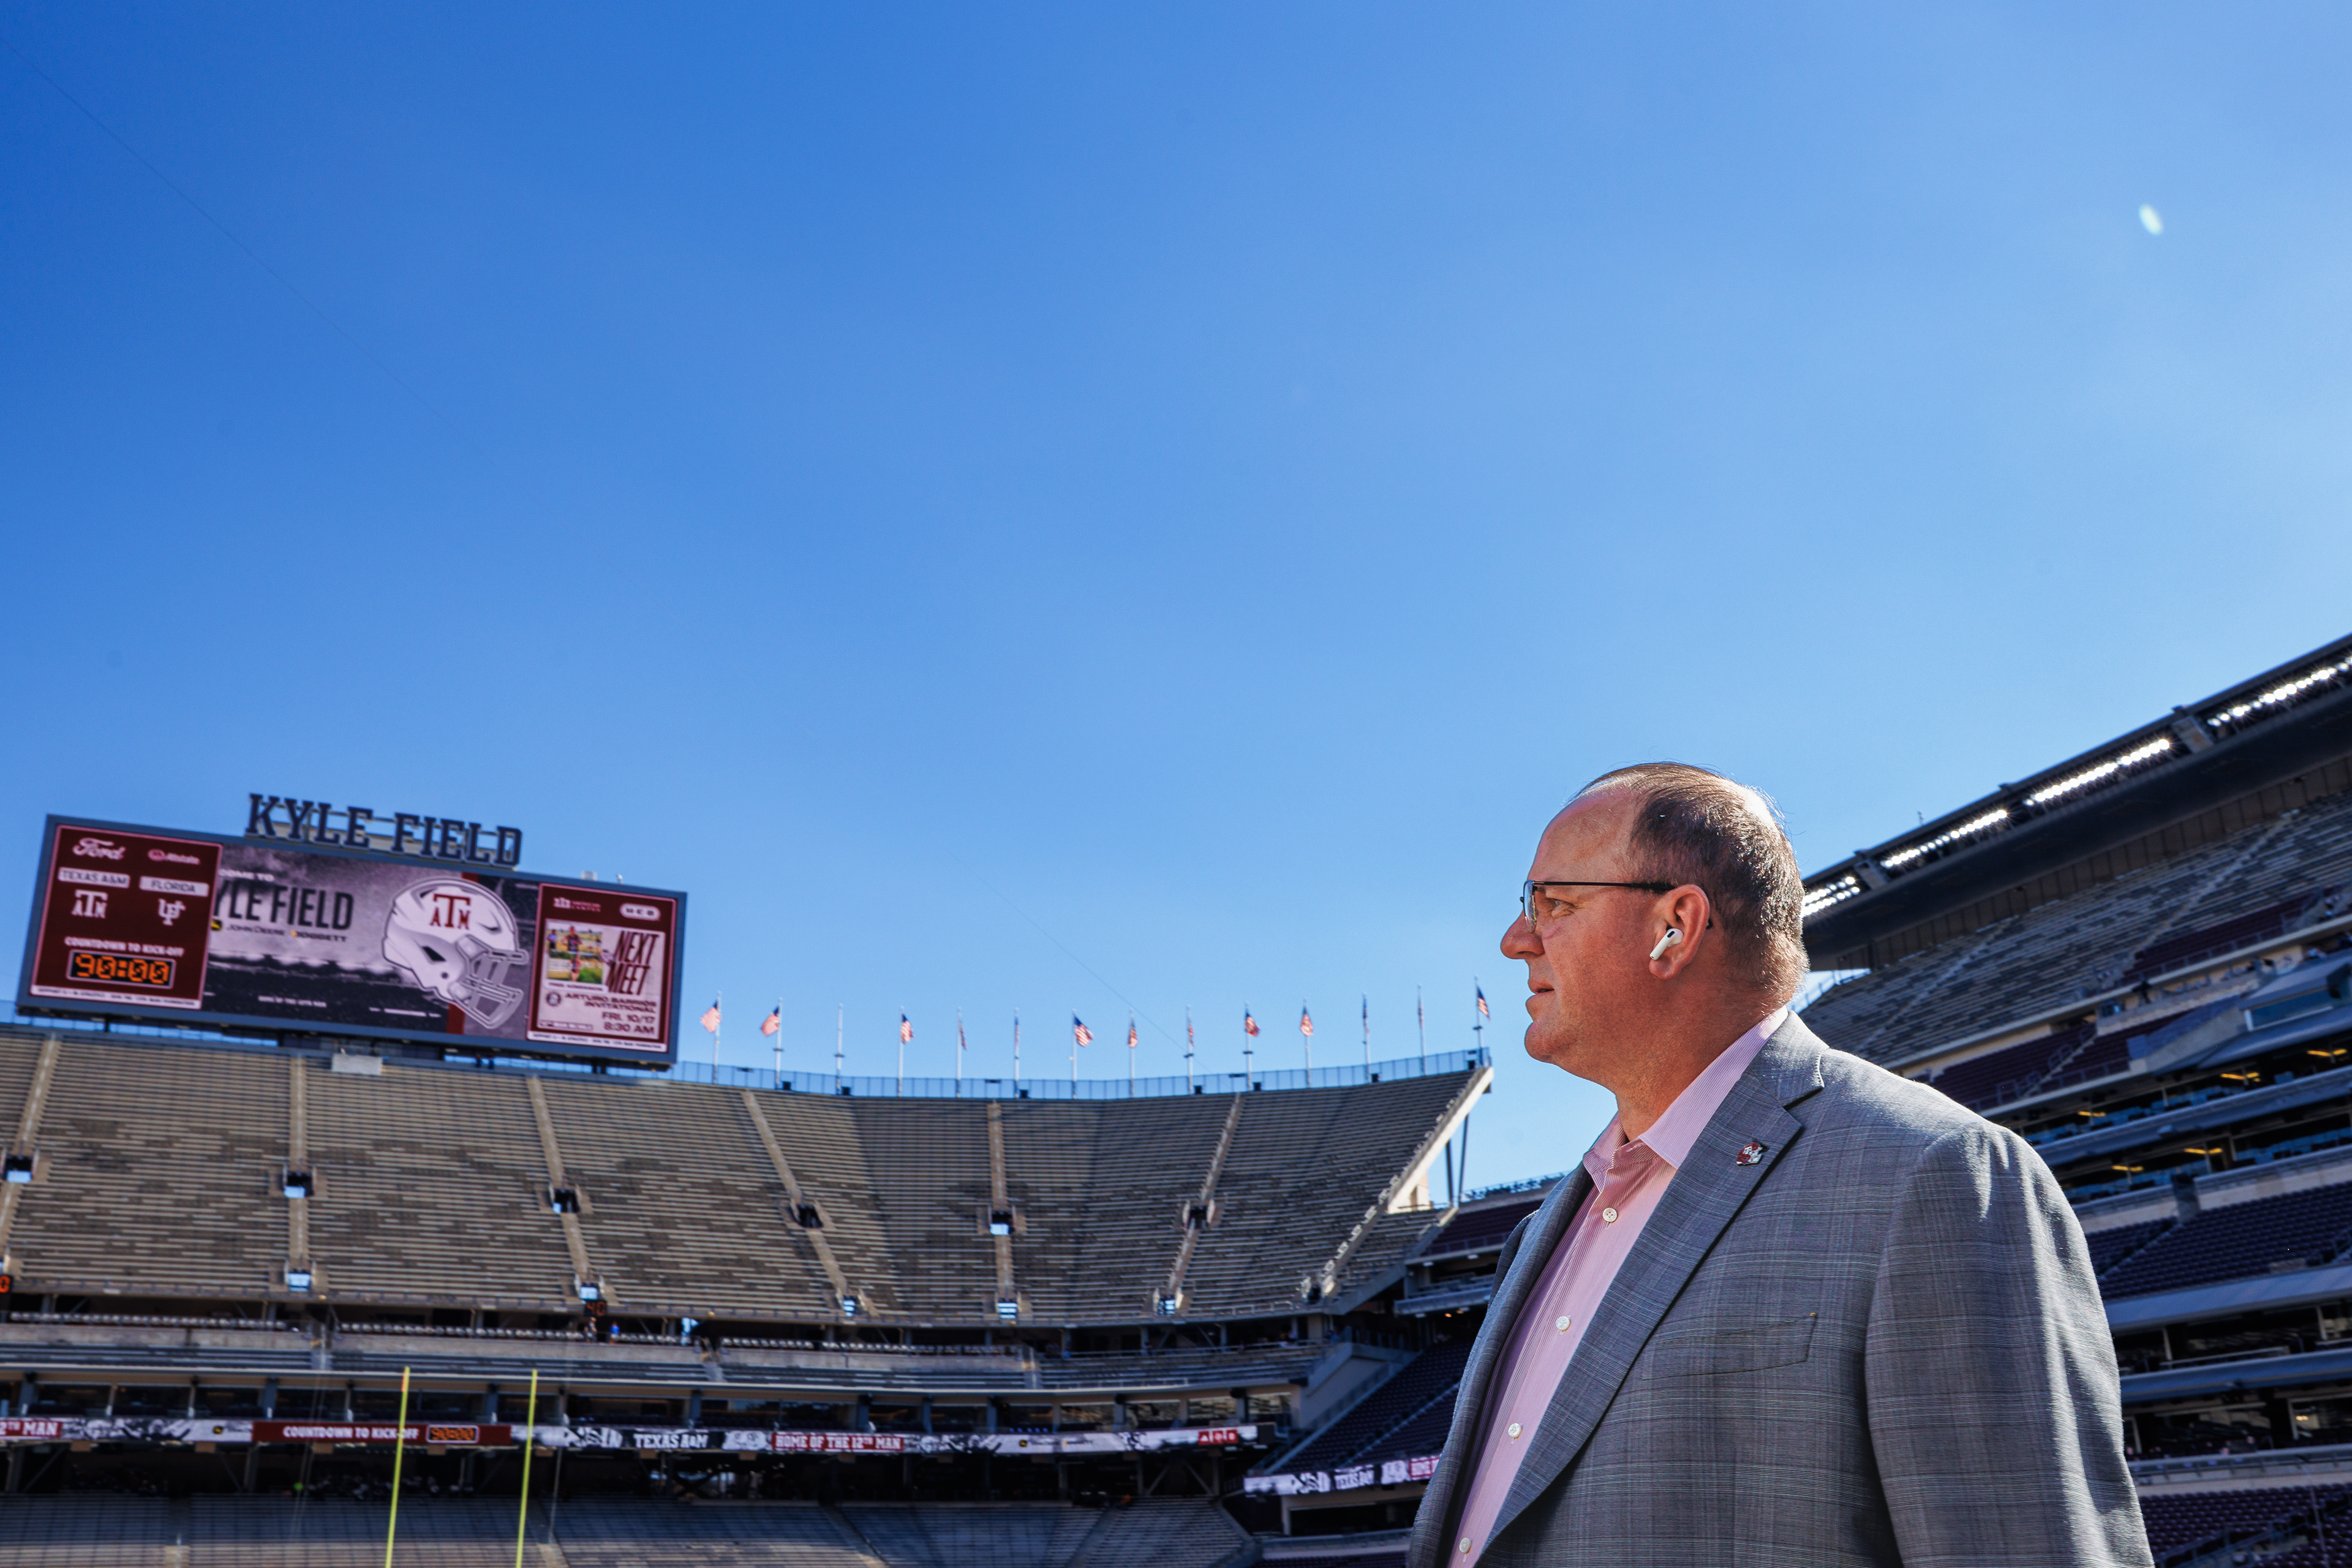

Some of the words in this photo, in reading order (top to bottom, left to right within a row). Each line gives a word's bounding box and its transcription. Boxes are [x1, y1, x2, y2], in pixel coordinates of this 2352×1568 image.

[246, 793, 373, 848] KYLE
[391, 812, 522, 867] FIELD
[72, 837, 126, 861] Ford
[62, 869, 98, 883] TEXAS
[101, 875, 127, 886] A&M
[151, 880, 197, 892] FLORIDA
[270, 884, 355, 930] FIELD
[64, 936, 127, 951] COUNTDOWN
[128, 943, 141, 952] TO
[612, 930, 660, 965] NEXT
[75, 954, 170, 984] 90:00
[606, 962, 650, 995] MEET
[634, 1025, 655, 1034] AM
[23, 1420, 58, 1437] MAN
[282, 1425, 353, 1438] COUNTDOWN
[355, 1427, 370, 1438] TO
[633, 1433, 679, 1449] TEXAS
[775, 1435, 808, 1449] HOME
[809, 1436, 824, 1448] OF
[826, 1436, 850, 1449] THE
[875, 1437, 901, 1450] MAN
